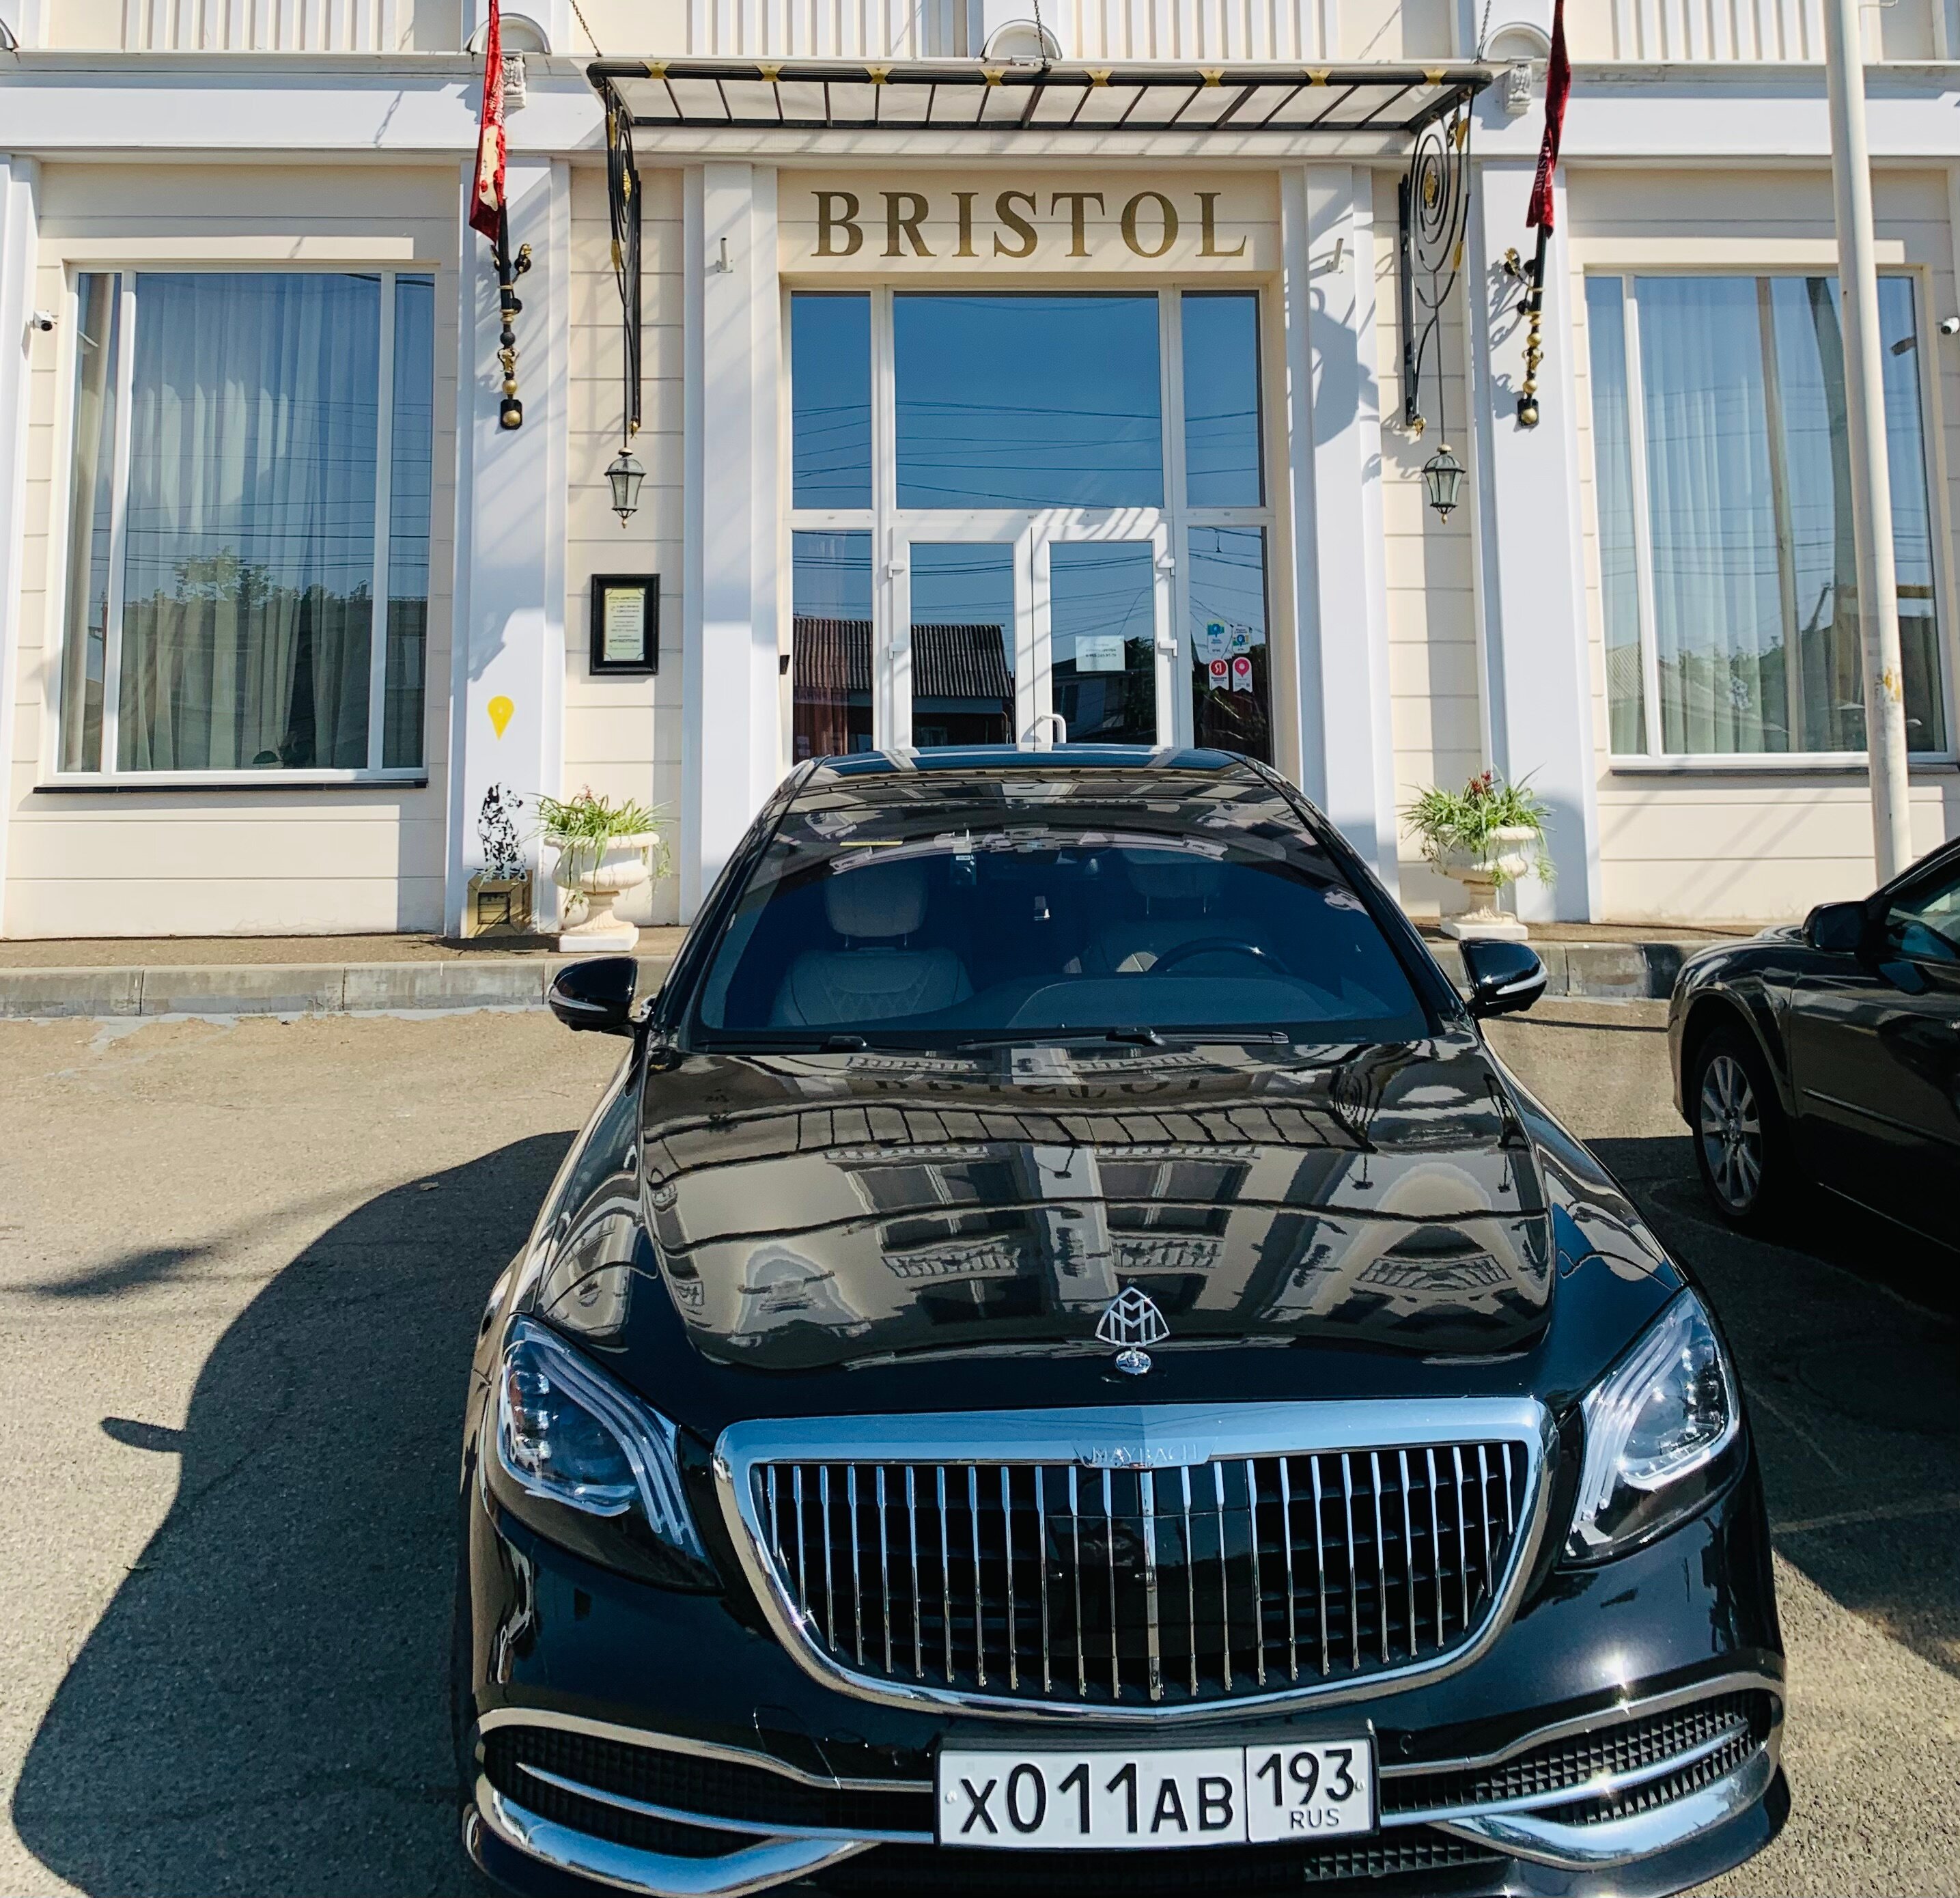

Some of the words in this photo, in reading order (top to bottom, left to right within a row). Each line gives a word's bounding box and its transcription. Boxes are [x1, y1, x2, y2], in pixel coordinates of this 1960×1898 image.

[1535, 138, 1548, 192] BRIS
[811, 191, 1246, 258] BRISTOL
[1257, 1749, 1354, 1806] 193
[1289, 1808, 1340, 1830] RUS
